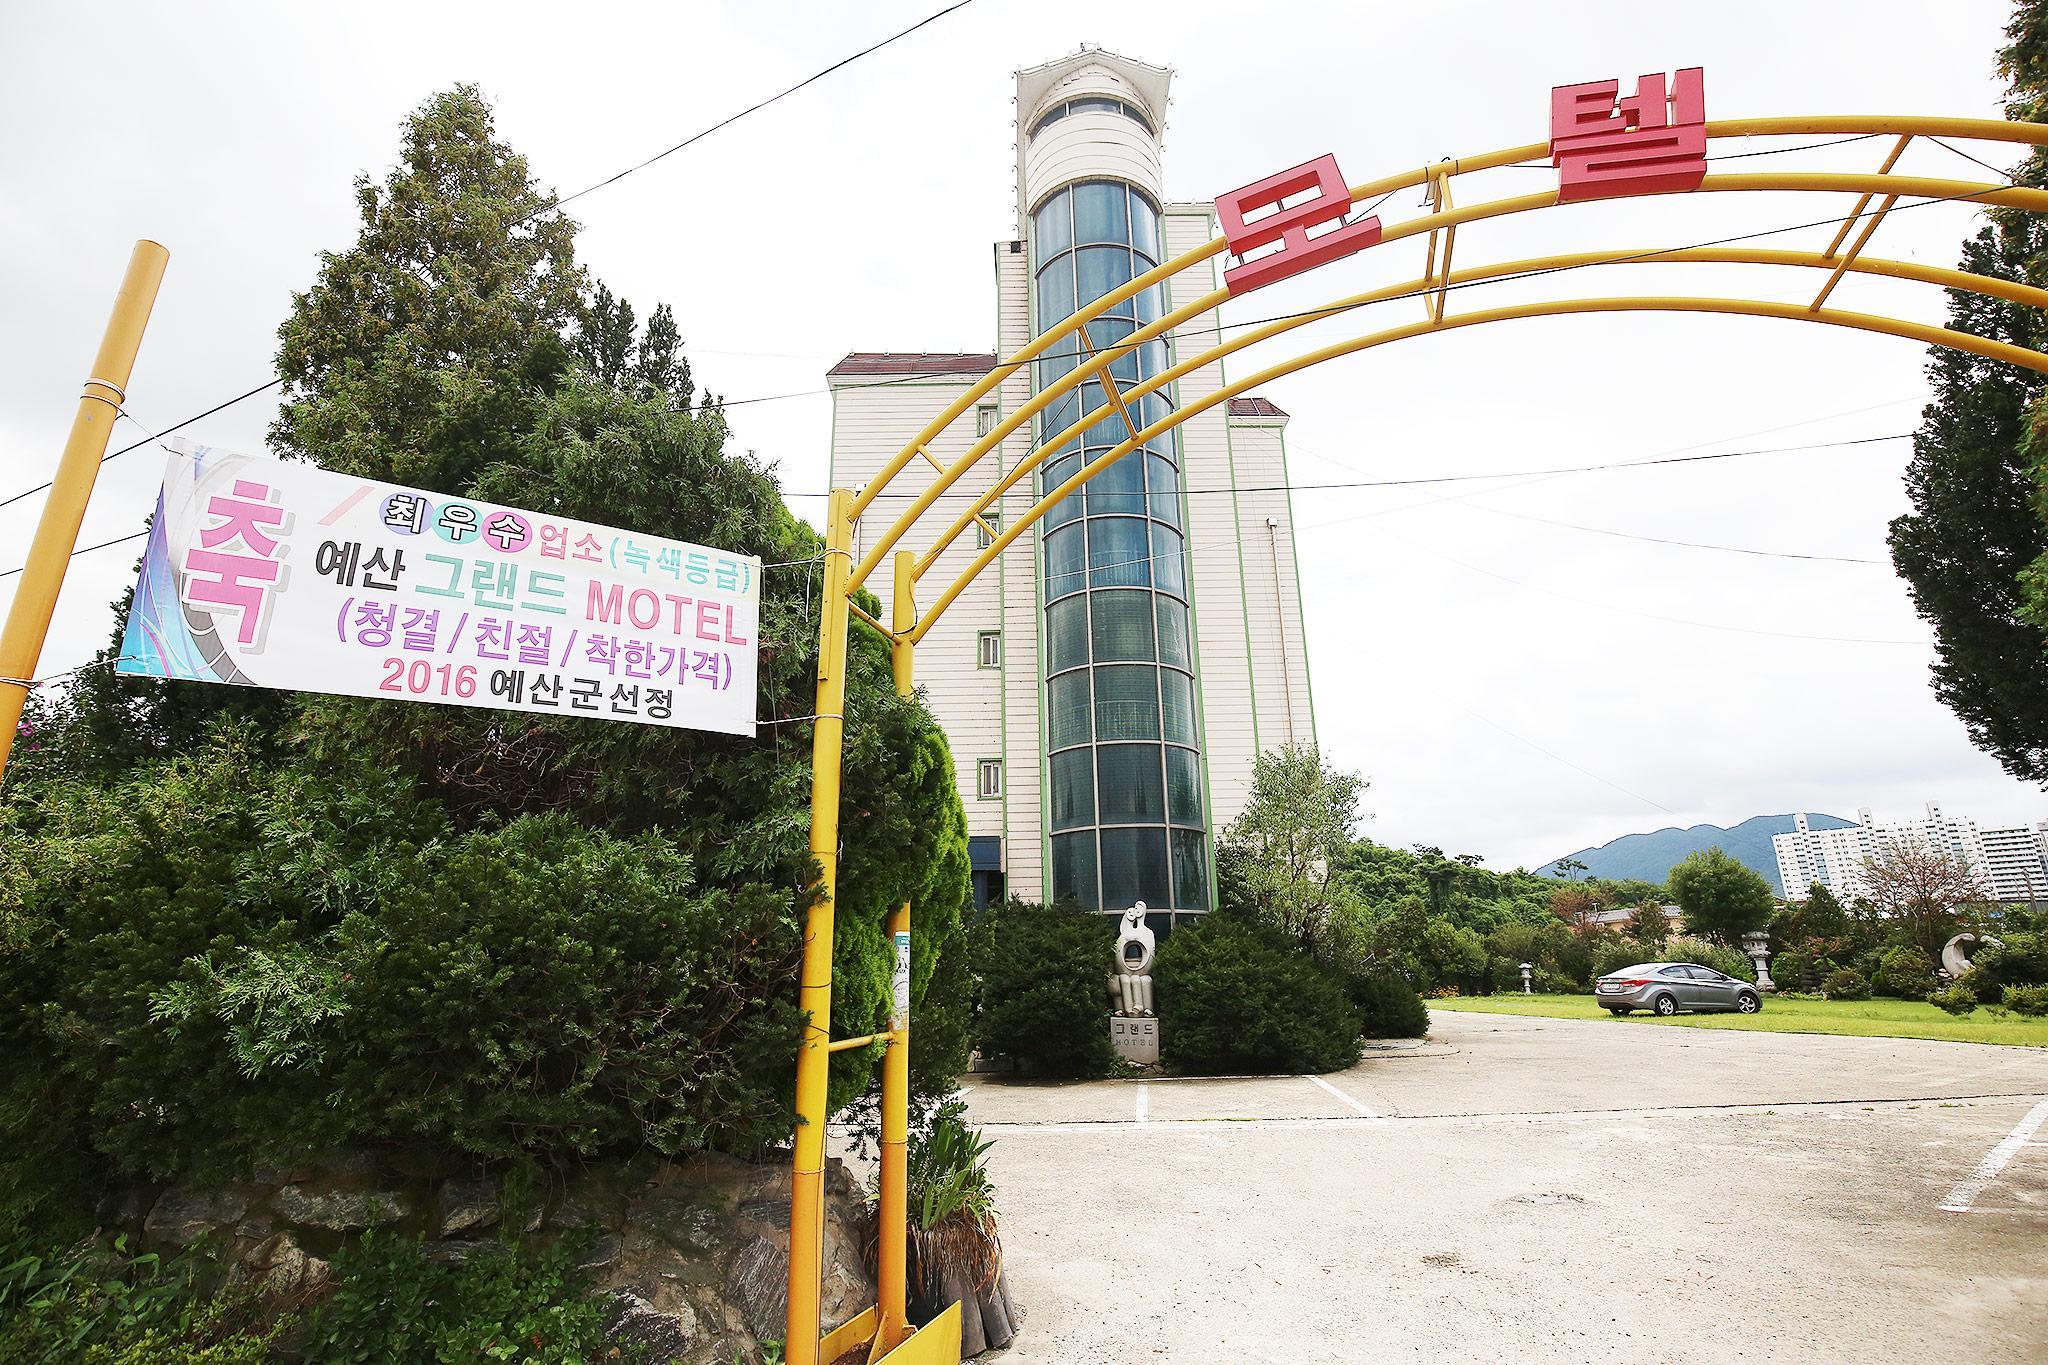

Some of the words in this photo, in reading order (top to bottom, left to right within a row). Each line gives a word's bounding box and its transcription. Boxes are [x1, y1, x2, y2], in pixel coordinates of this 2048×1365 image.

[185, 479, 284, 644] 축
[314, 540, 406, 592] 예산
[414, 553, 568, 616] 그랜드
[585, 580, 748, 646] MOTEL
[379, 657, 478, 698] 2016
[1115, 1022, 1154, 1036] 그랜드
